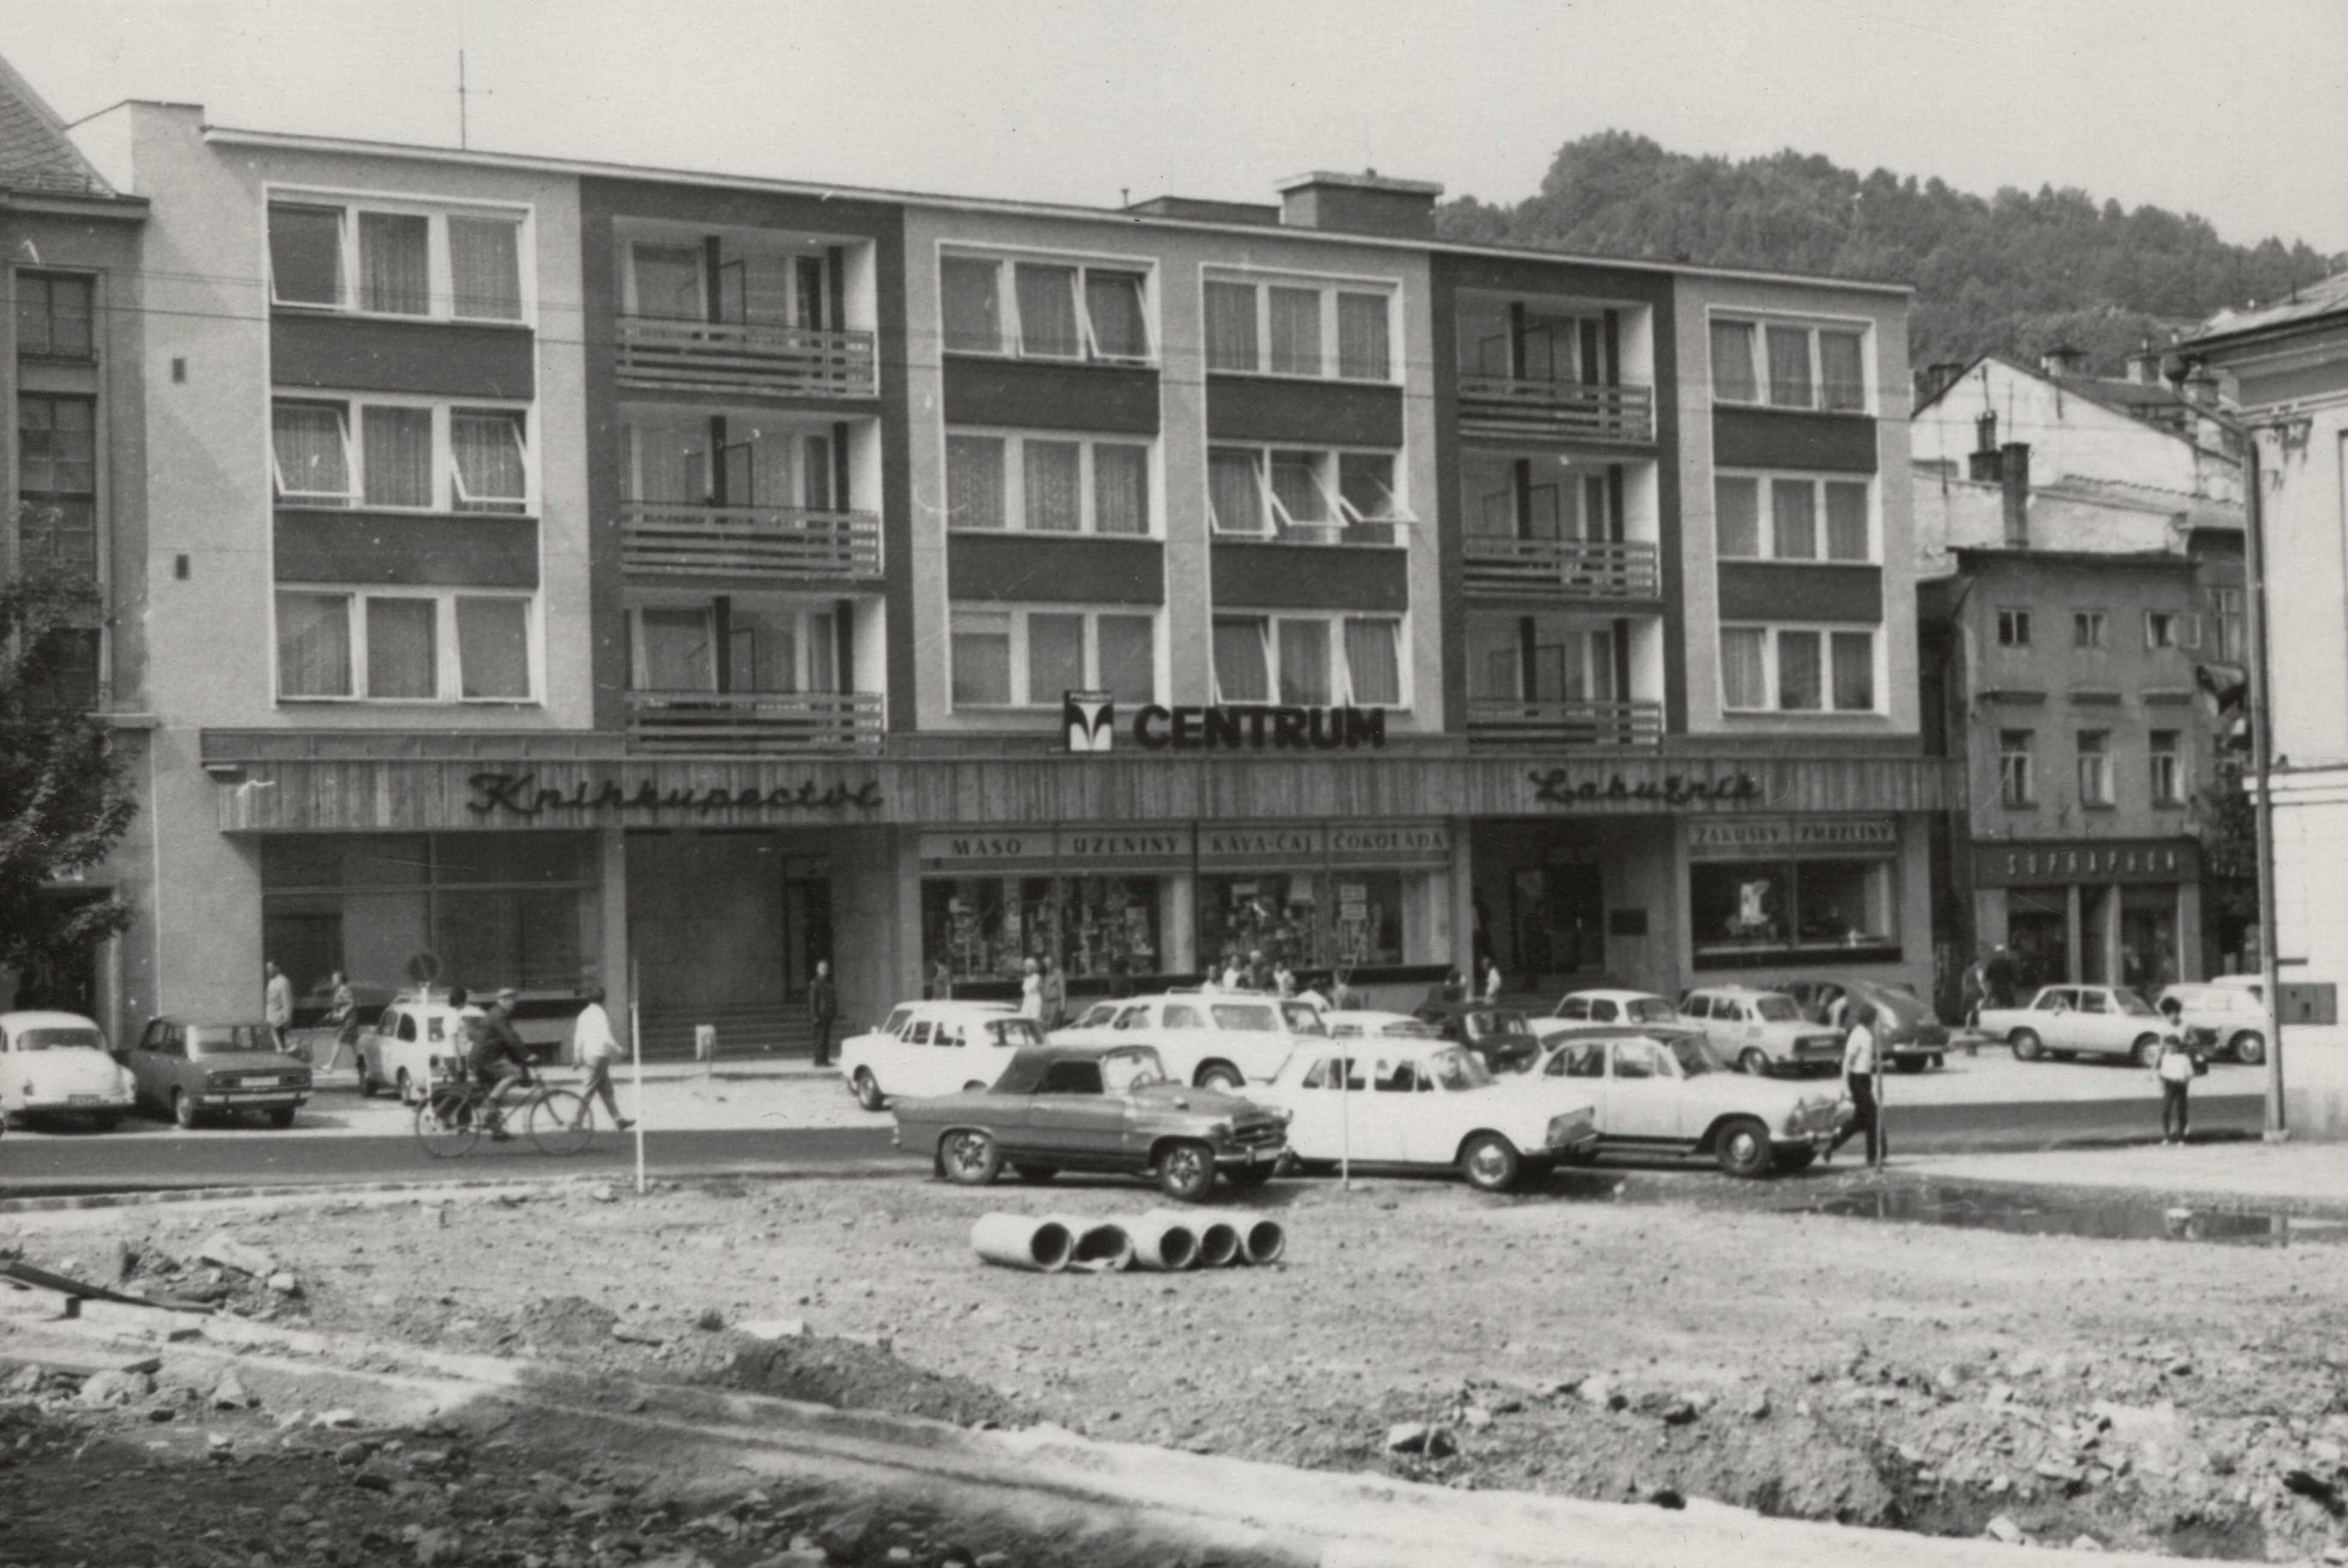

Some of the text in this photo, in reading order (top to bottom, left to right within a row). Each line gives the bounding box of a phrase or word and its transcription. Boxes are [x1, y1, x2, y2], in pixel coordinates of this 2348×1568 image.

[1133, 704, 1385, 749] CENTRUM
[951, 837, 1178, 856] MASO UZENINY
[2008, 851, 2177, 876] SUPRAPHON
